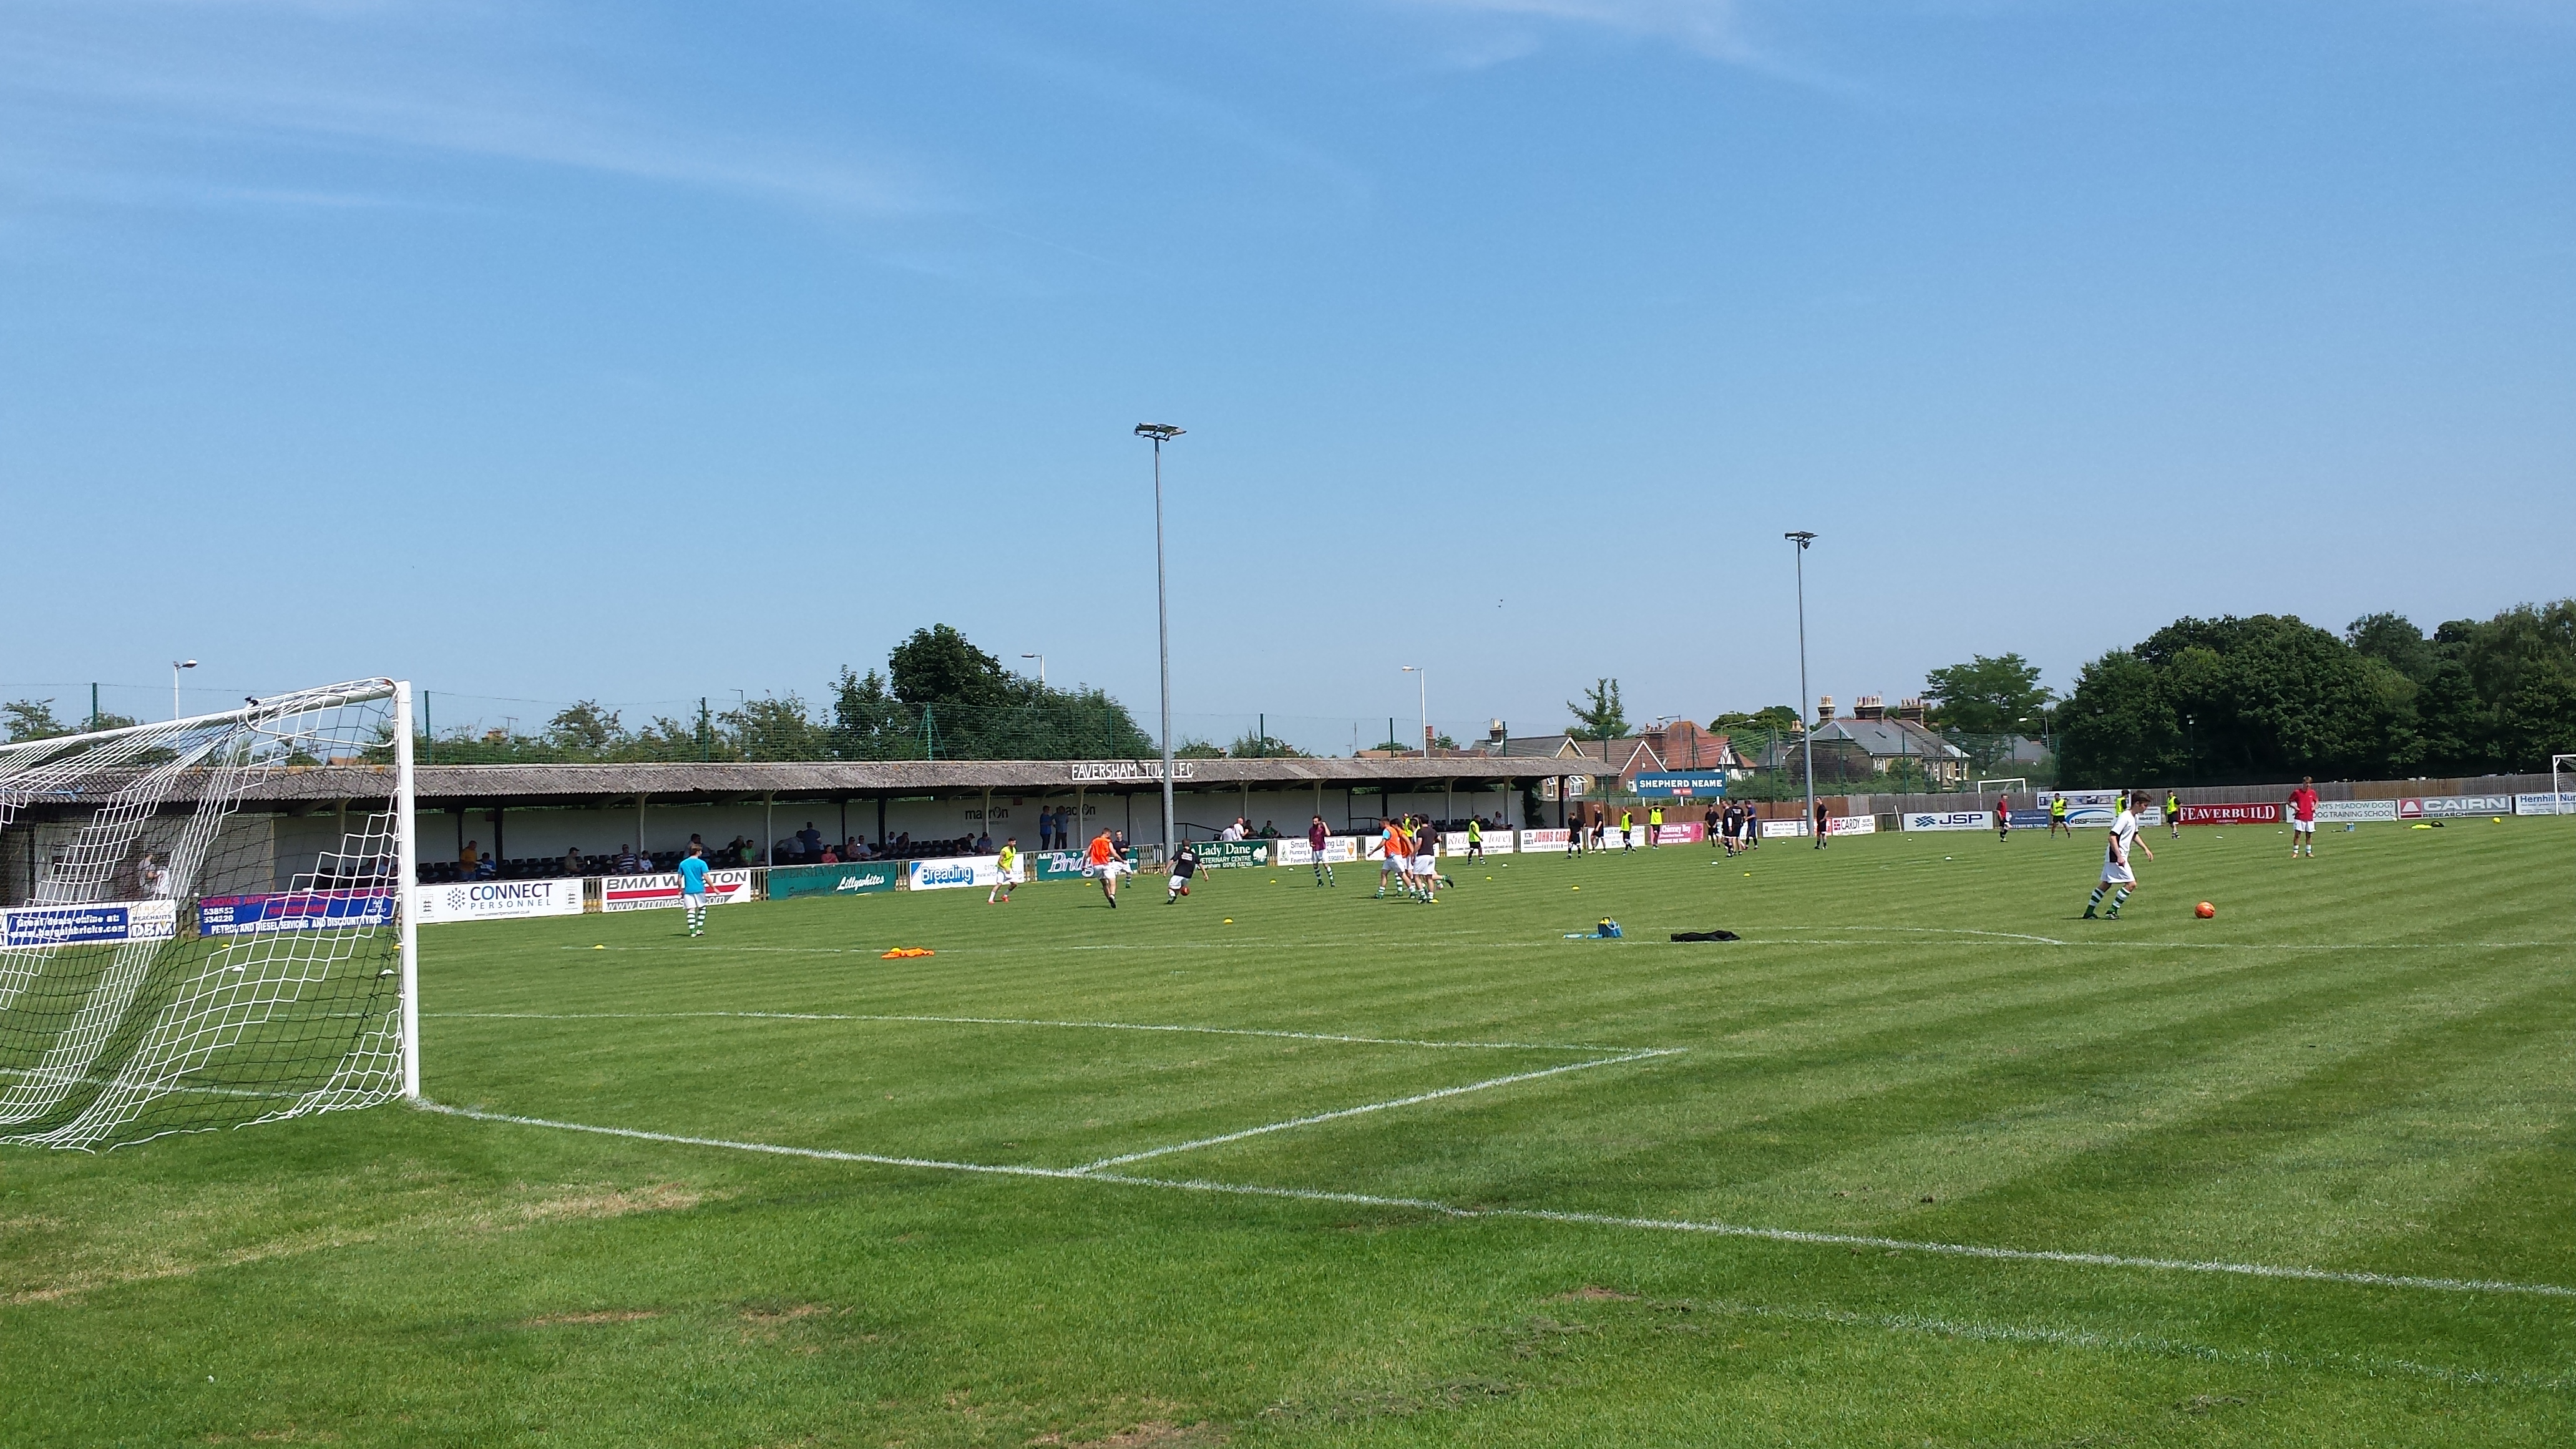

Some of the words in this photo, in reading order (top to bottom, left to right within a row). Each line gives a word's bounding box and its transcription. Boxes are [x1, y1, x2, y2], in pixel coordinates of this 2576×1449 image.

[1072, 763, 1138, 779] FAVERSHAM
[1180, 763, 1193, 778] FC
[1639, 779, 1689, 788] SHEPHERD
[1692, 779, 1722, 788] NEAME
[2423, 798, 2506, 811] CAIRN
[2520, 794, 2555, 803] Hernhill
[965, 806, 1008, 819] maron
[1939, 814, 1983, 824] JSP
[2180, 805, 2275, 821] FEAVERBUILD
[1842, 818, 1860, 829] CARDY
[1534, 831, 1554, 842] JOHNS
[1198, 843, 1222, 857] Lady
[1225, 843, 1251, 854] Dane
[922, 865, 972, 884] Breading
[607, 876, 657, 890] BMM
[836, 873, 885, 892] Lillywhites
[470, 882, 553, 900] CONNECT
[201, 897, 240, 907] COOKS
[471, 899, 552, 910] PERSONNEL
[240, 923, 255, 933] AND
[256, 922, 278, 932] DIESEL
[280, 919, 309, 930] SERVICING
[312, 918, 326, 928] AND
